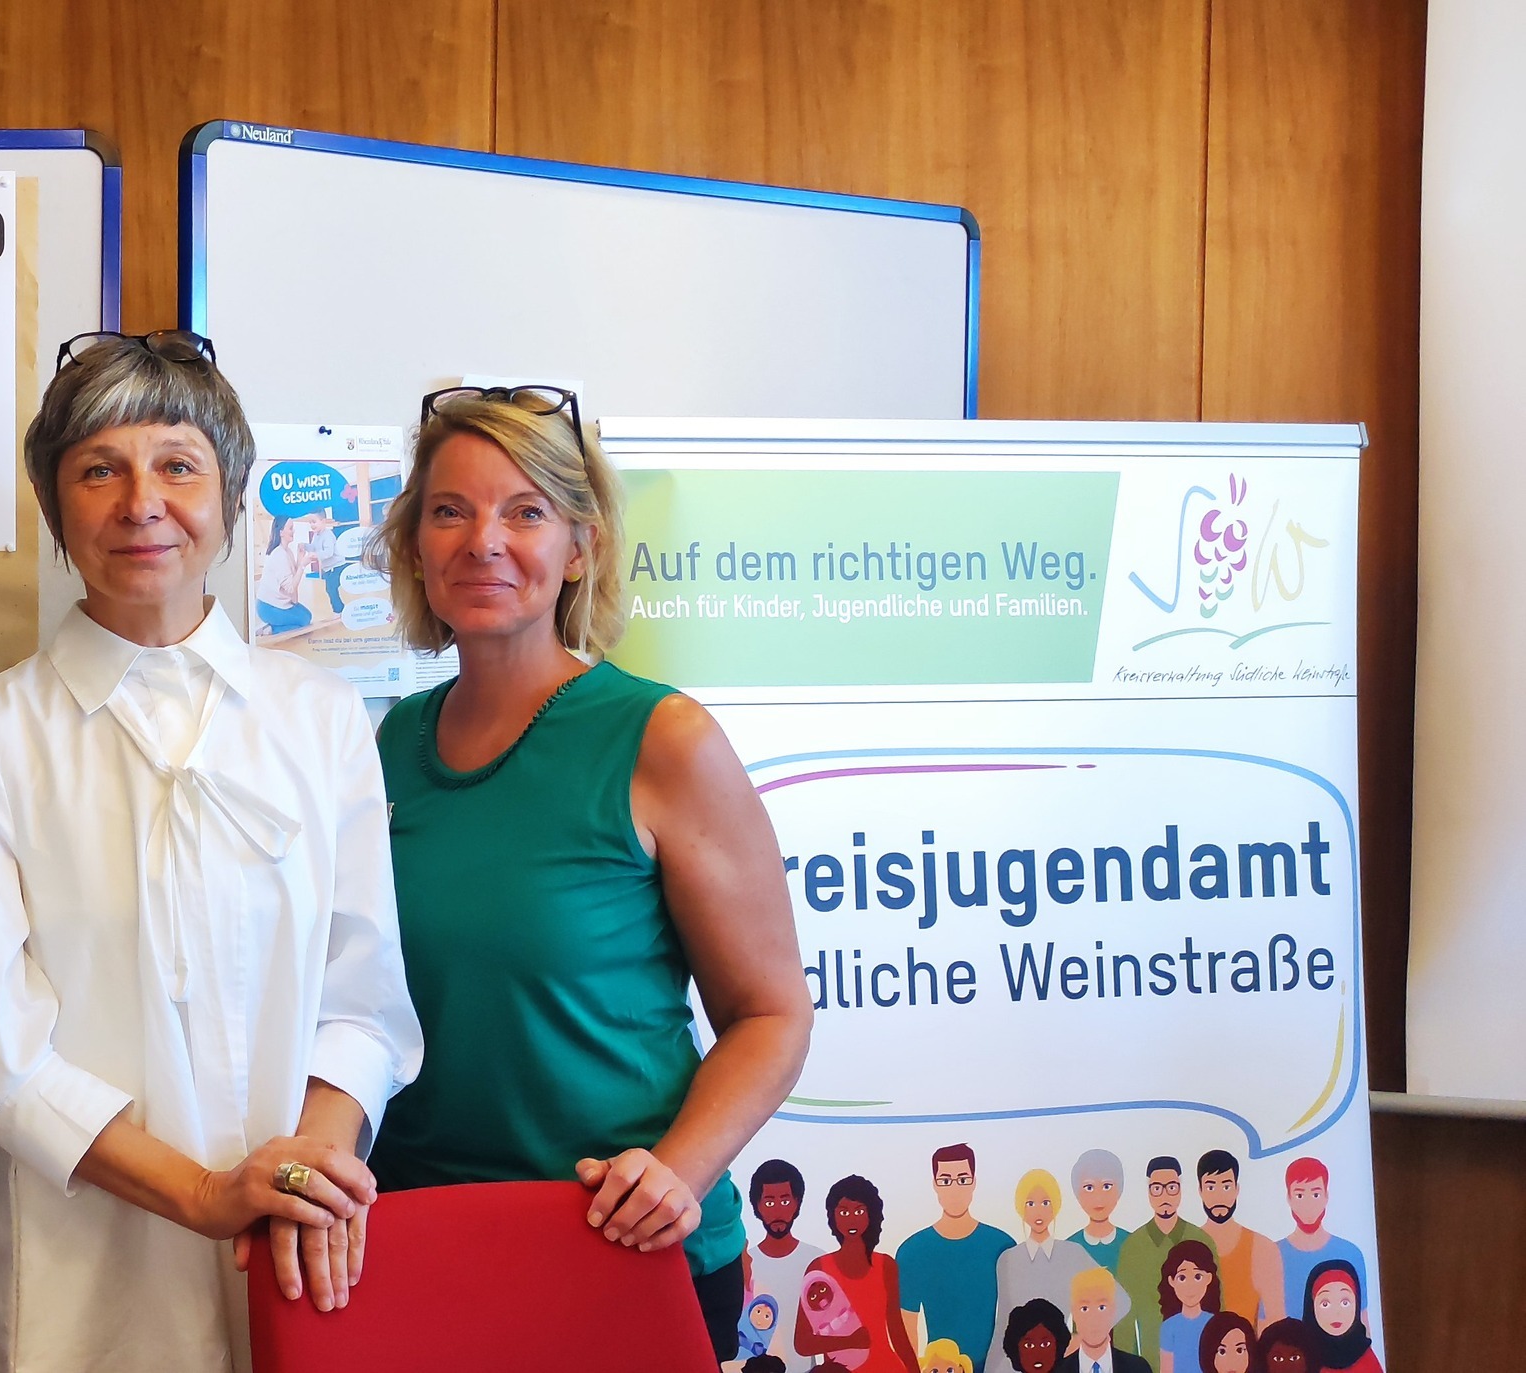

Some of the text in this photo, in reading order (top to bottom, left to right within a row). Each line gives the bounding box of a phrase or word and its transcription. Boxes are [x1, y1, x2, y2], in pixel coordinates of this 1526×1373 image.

[241, 124, 293, 144] Neuland
[271, 473, 331, 491] DU WIRST
[282, 488, 332, 504] GESUCHT!
[629, 541, 1097, 591] Auf dem richtigen Weg.
[629, 592, 1089, 624] Auch für Kinder, Jugendliche und Familien.
[1112, 660, 1351, 687] Kreisverwaltung Südliche Weinstraße
[782, 821, 1331, 929] eisjugendamt
[804, 934, 1335, 1010] dliche Weinstraße
